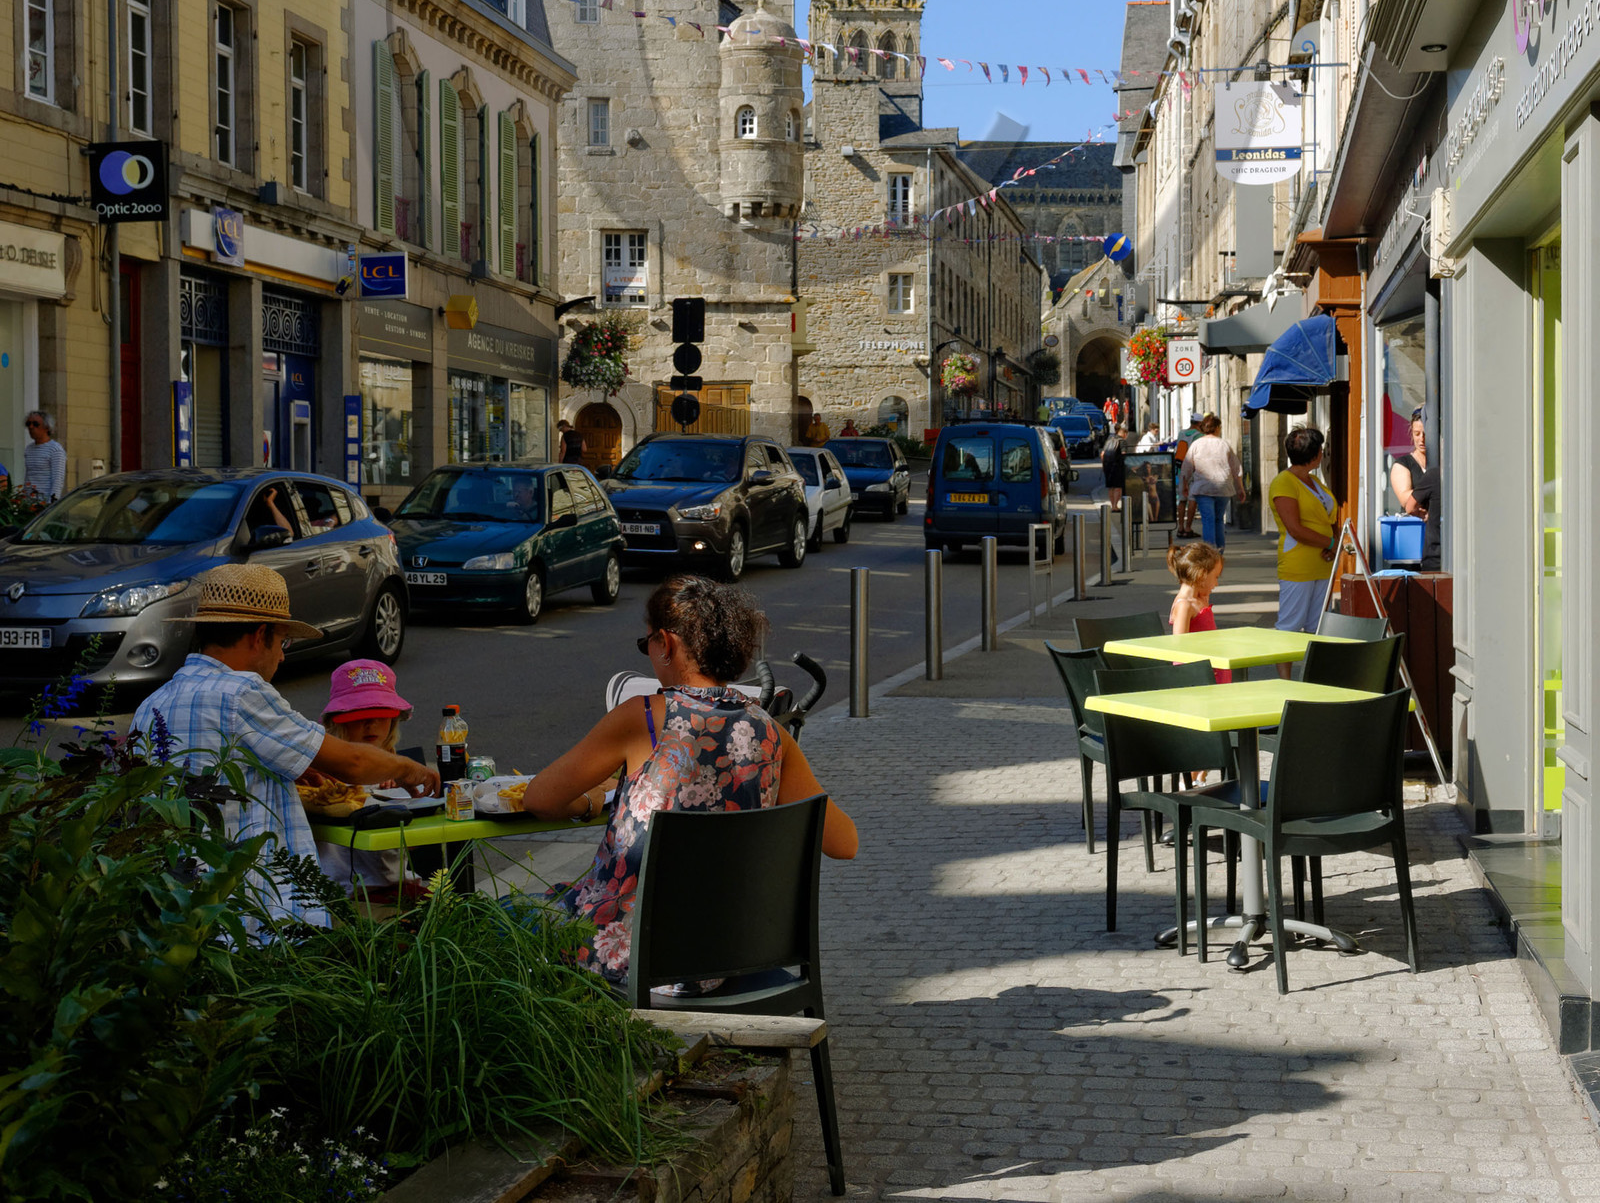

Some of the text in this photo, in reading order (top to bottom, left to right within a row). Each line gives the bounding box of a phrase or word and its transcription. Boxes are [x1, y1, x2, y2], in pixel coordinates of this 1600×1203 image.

[1562, 20, 1583, 79] place
[1231, 148, 1287, 160] Leonidas
[1249, 166, 1287, 174] DRAGEOIR
[96, 202, 162, 218] Optic 2000
[218, 217, 240, 239] LCL
[362, 265, 400, 278] LCL
[364, 306, 379, 316] VENTE
[384, 311, 408, 323] LOCATION
[385, 324, 405, 335] GESTION
[410, 329, 427, 340] SYNDIC
[468, 332, 535, 362] AGENCE DU KREISKER
[1179, 363, 1191, 372] 30
[419, 574, 431, 584] YL
[433, 574, 446, 584] 29
